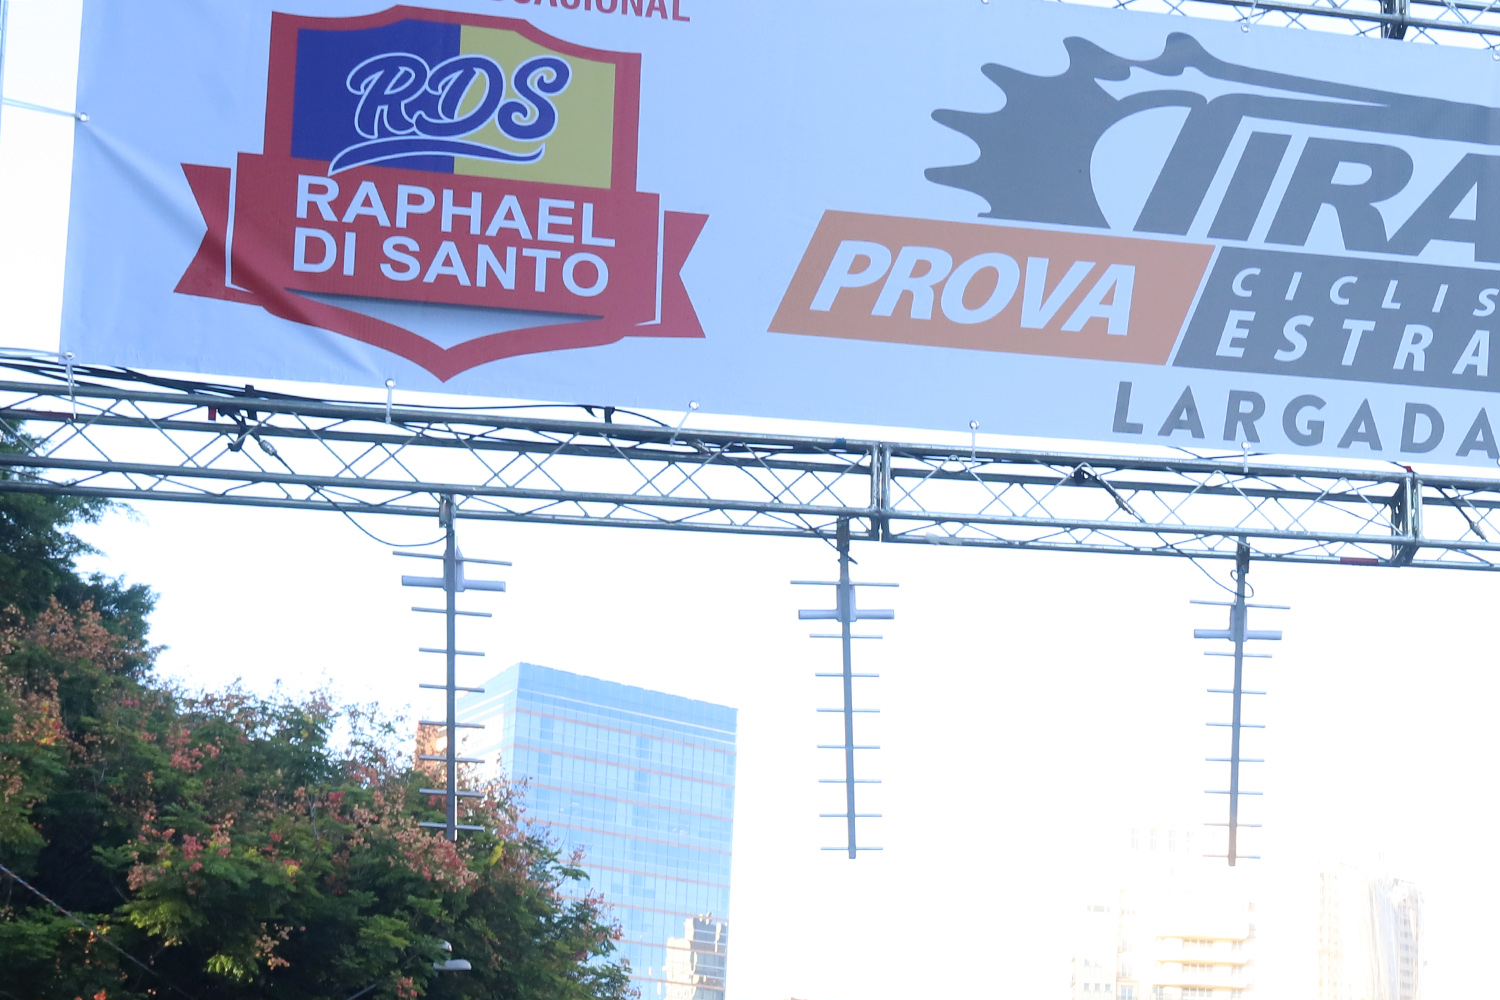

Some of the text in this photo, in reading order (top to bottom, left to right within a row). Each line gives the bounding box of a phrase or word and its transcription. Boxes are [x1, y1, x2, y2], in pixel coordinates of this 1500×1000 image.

[346, 52, 572, 140] RDS
[296, 174, 616, 248] RAPHAEL
[293, 227, 609, 297] DI SANTO
[810, 239, 1136, 336] PROVA
[1112, 381, 1500, 461] LARGADA
